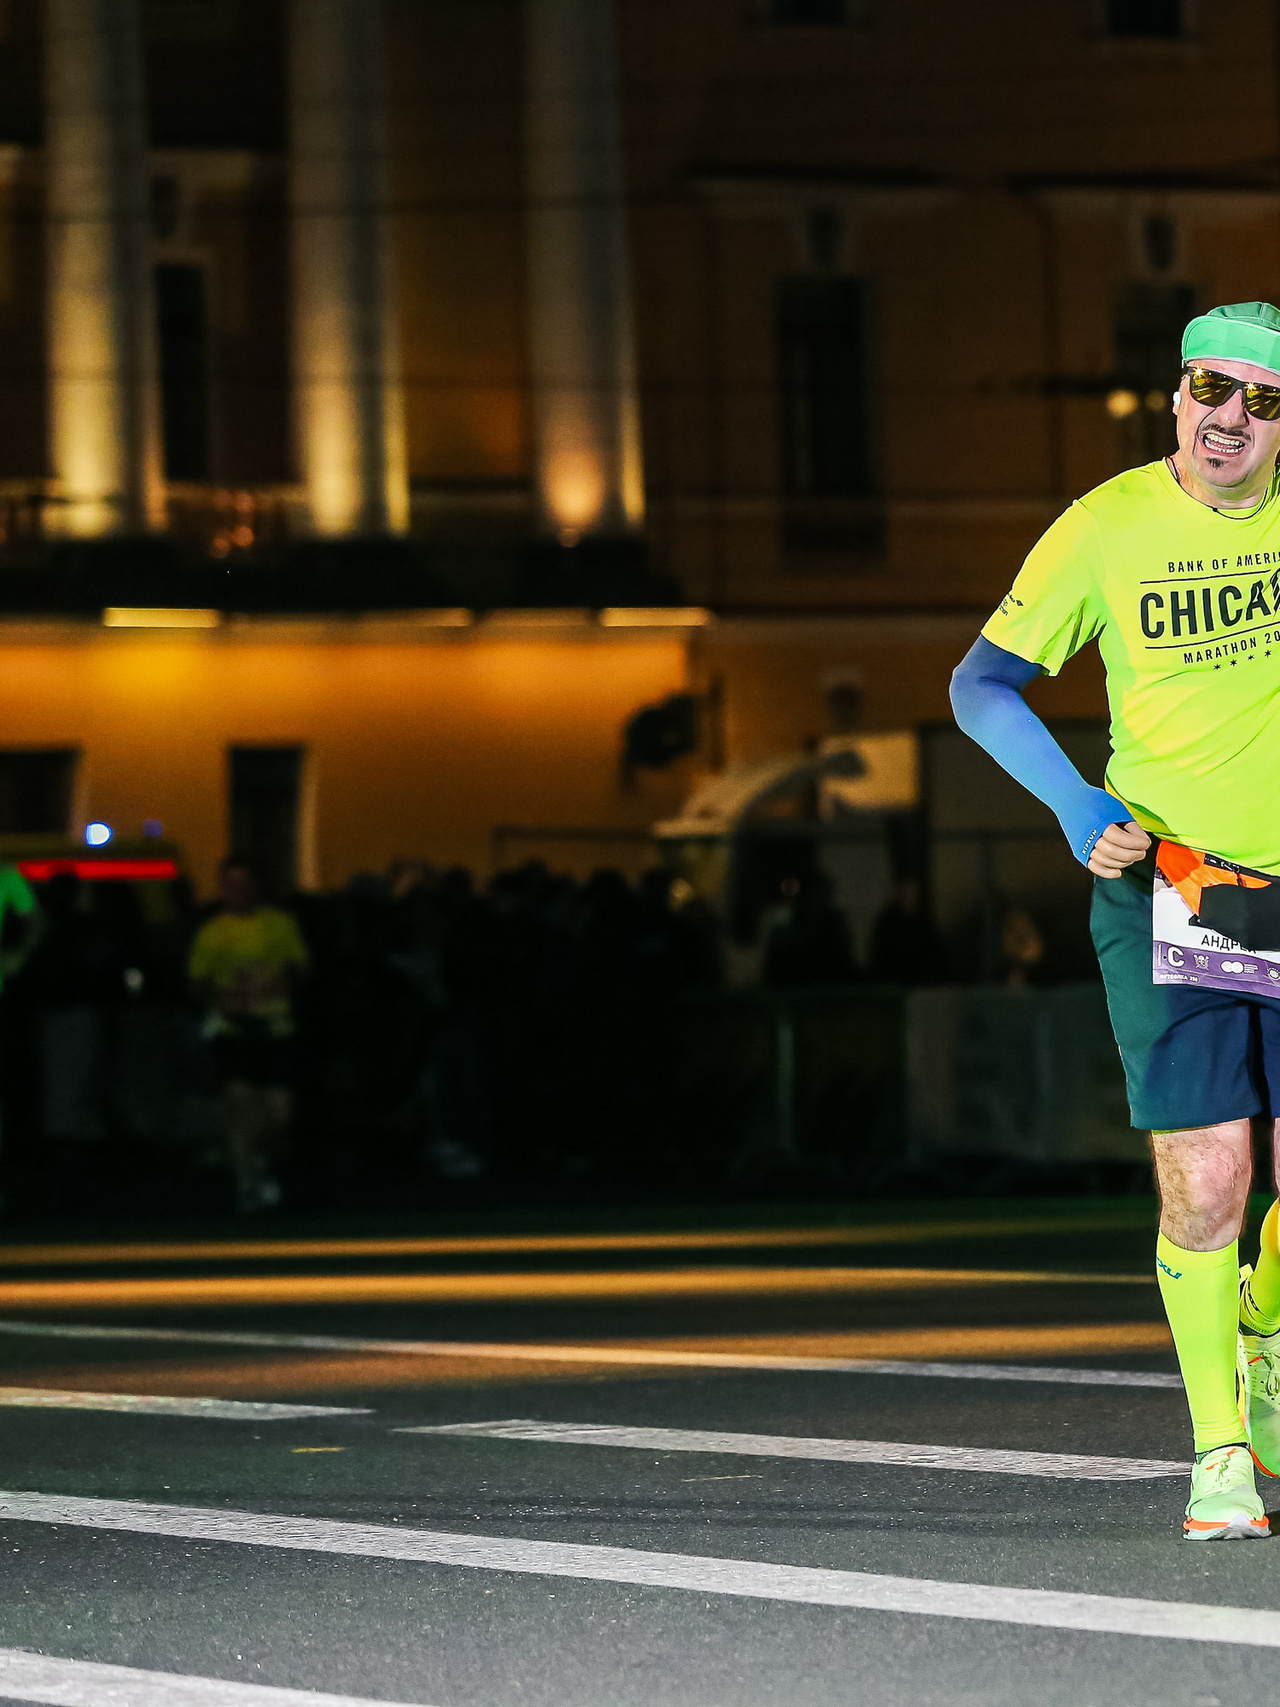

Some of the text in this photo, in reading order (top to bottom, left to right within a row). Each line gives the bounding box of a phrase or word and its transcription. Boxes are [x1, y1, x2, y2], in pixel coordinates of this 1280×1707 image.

[1168, 560, 1204, 573] BANK
[1212, 558, 1229, 570] OF
[1184, 637, 1258, 664] MARATHON
[1201, 934, 1256, 954] АНДР
[1156, 1256, 1183, 1280] XU
